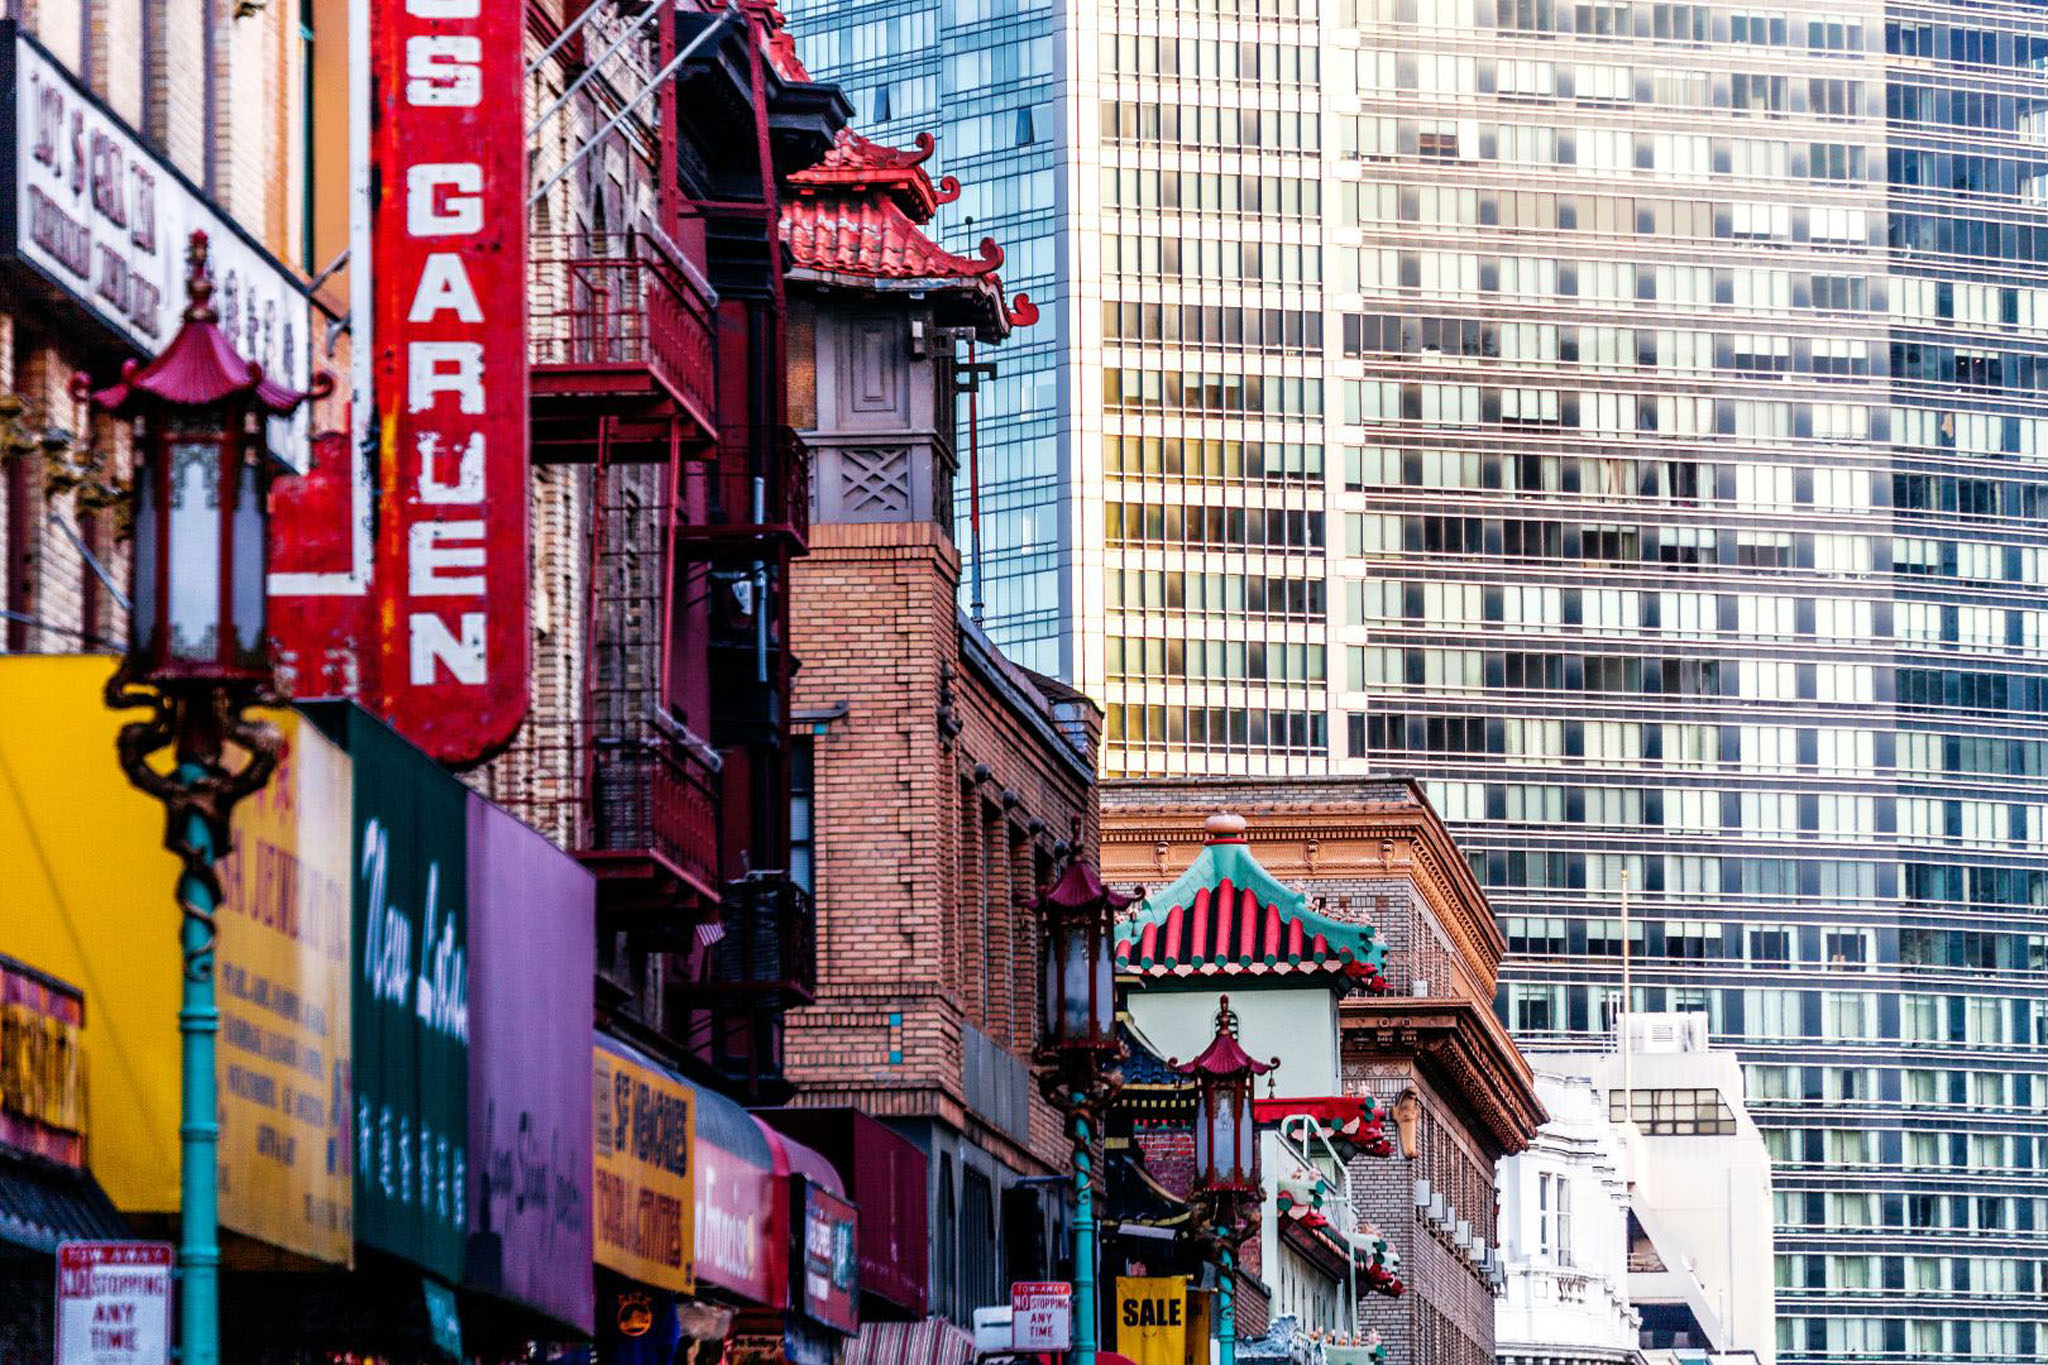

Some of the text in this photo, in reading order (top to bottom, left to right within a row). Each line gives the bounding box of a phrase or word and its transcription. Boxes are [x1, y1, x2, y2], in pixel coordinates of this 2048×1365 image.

[406, 0, 483, 107] S
[91, 1273, 164, 1296] STOPPING
[93, 1302, 137, 1322] ANY
[1014, 1295, 1067, 1310] NO STOPPING
[1123, 1298, 1181, 1326] SALE
[1031, 1313, 1052, 1324] ANY
[90, 1327, 138, 1352] TIME
[1030, 1326, 1053, 1338] TIME
